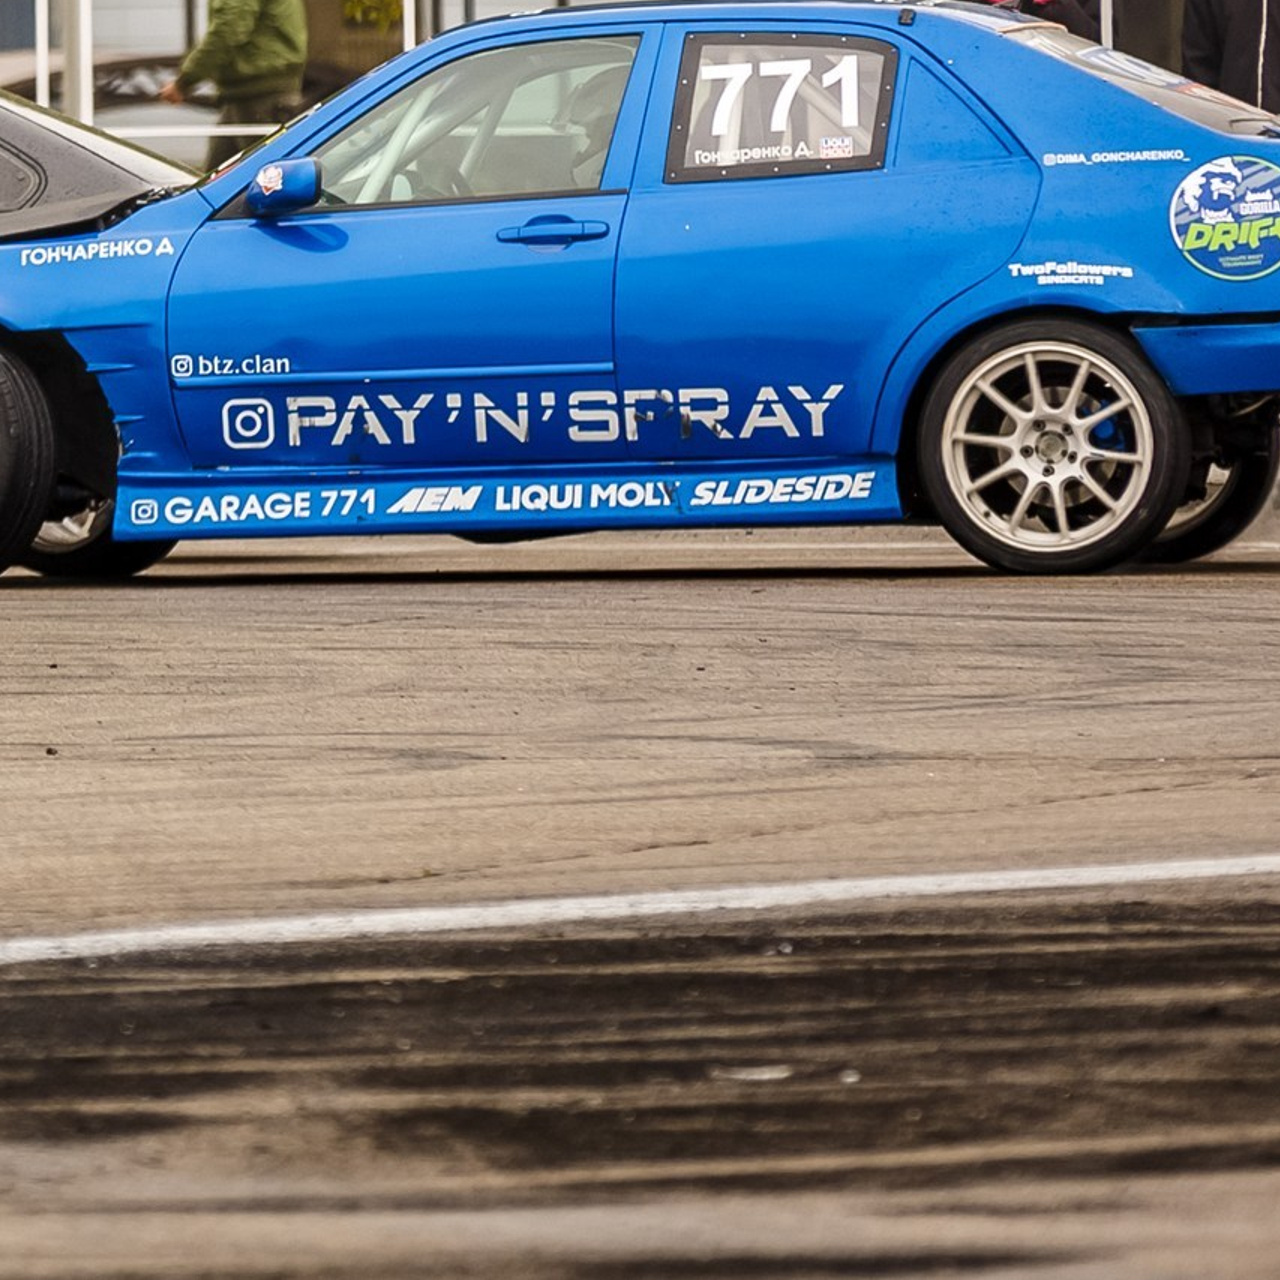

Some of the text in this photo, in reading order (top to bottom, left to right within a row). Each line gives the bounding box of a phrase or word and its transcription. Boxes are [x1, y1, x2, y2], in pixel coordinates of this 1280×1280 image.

[701, 55, 859, 136] 771
[694, 141, 814, 165] Гонаренко Д.
[21, 237, 174, 266] ГОНЧАРЕНКО Д
[1008, 261, 1133, 277] TwoFollowers
[198, 355, 290, 374] btz.clan
[164, 472, 875, 524] GARAGE 771 AEM LIQUI MOLY SLIDESIDE
